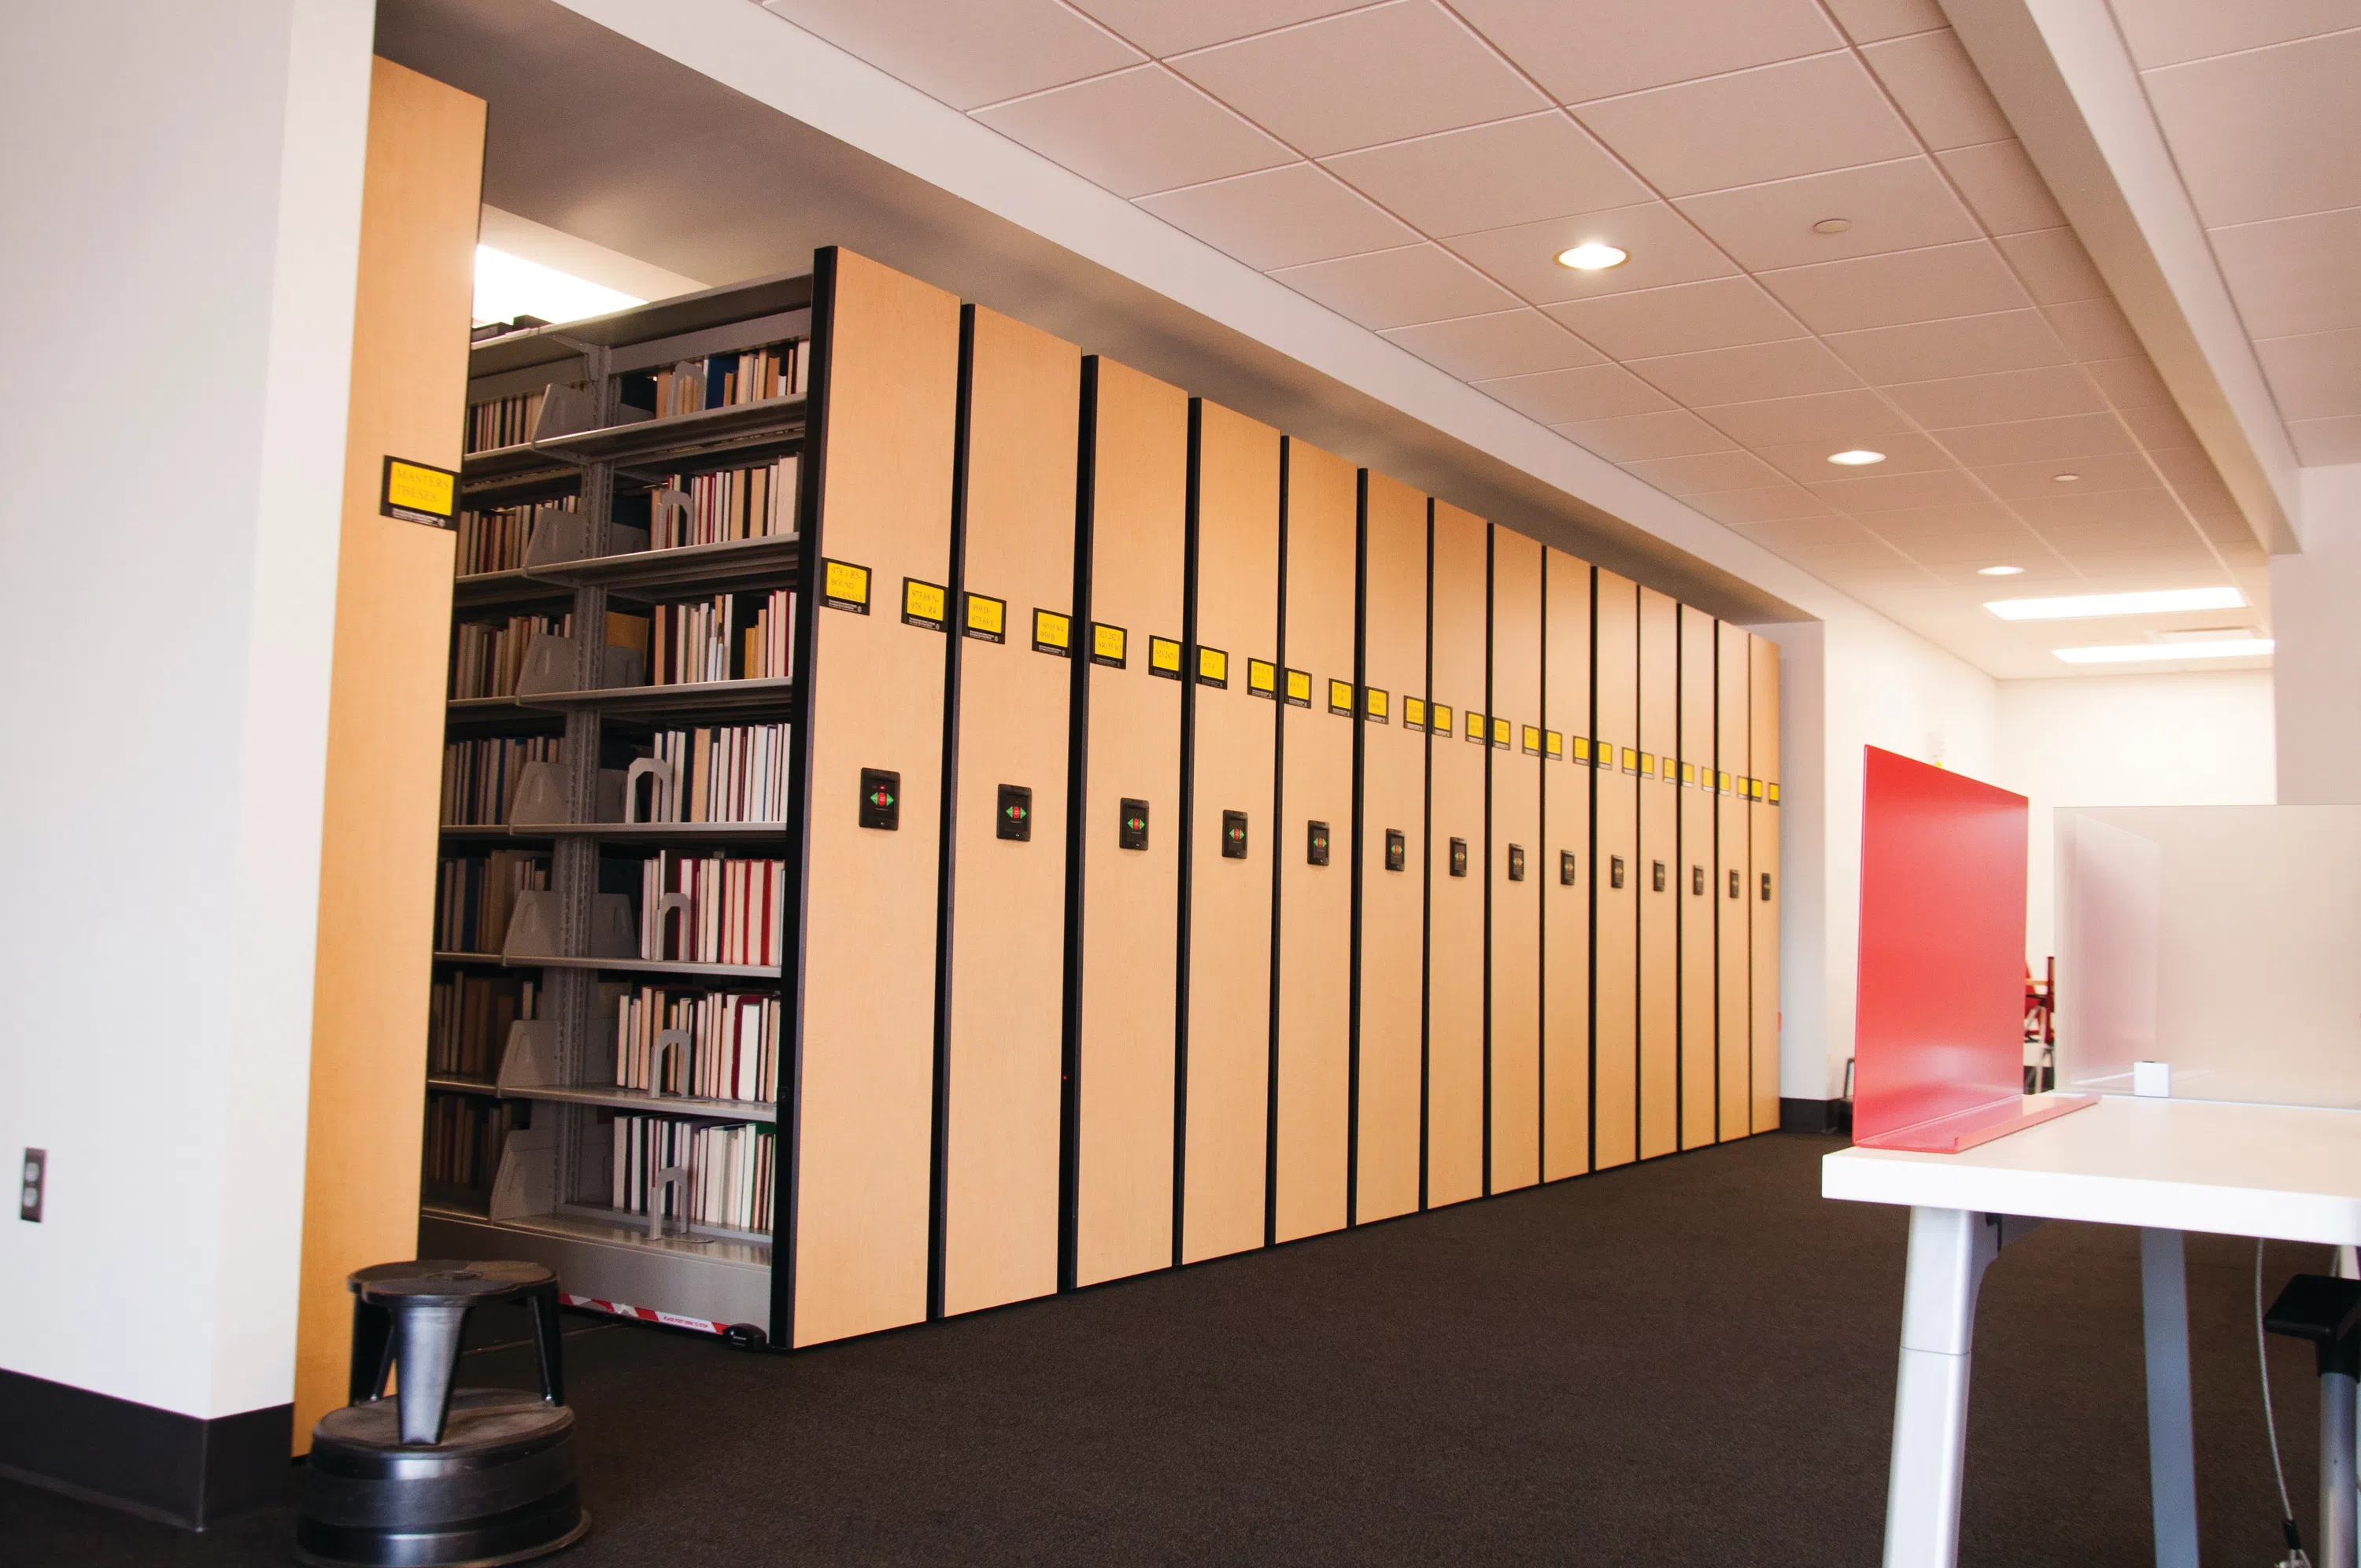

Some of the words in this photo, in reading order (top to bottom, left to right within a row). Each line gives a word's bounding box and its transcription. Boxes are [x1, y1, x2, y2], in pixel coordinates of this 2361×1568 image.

[396, 468, 450, 490] MASTERS
[396, 483, 438, 502] THESES
[830, 578, 854, 589] BOUND
